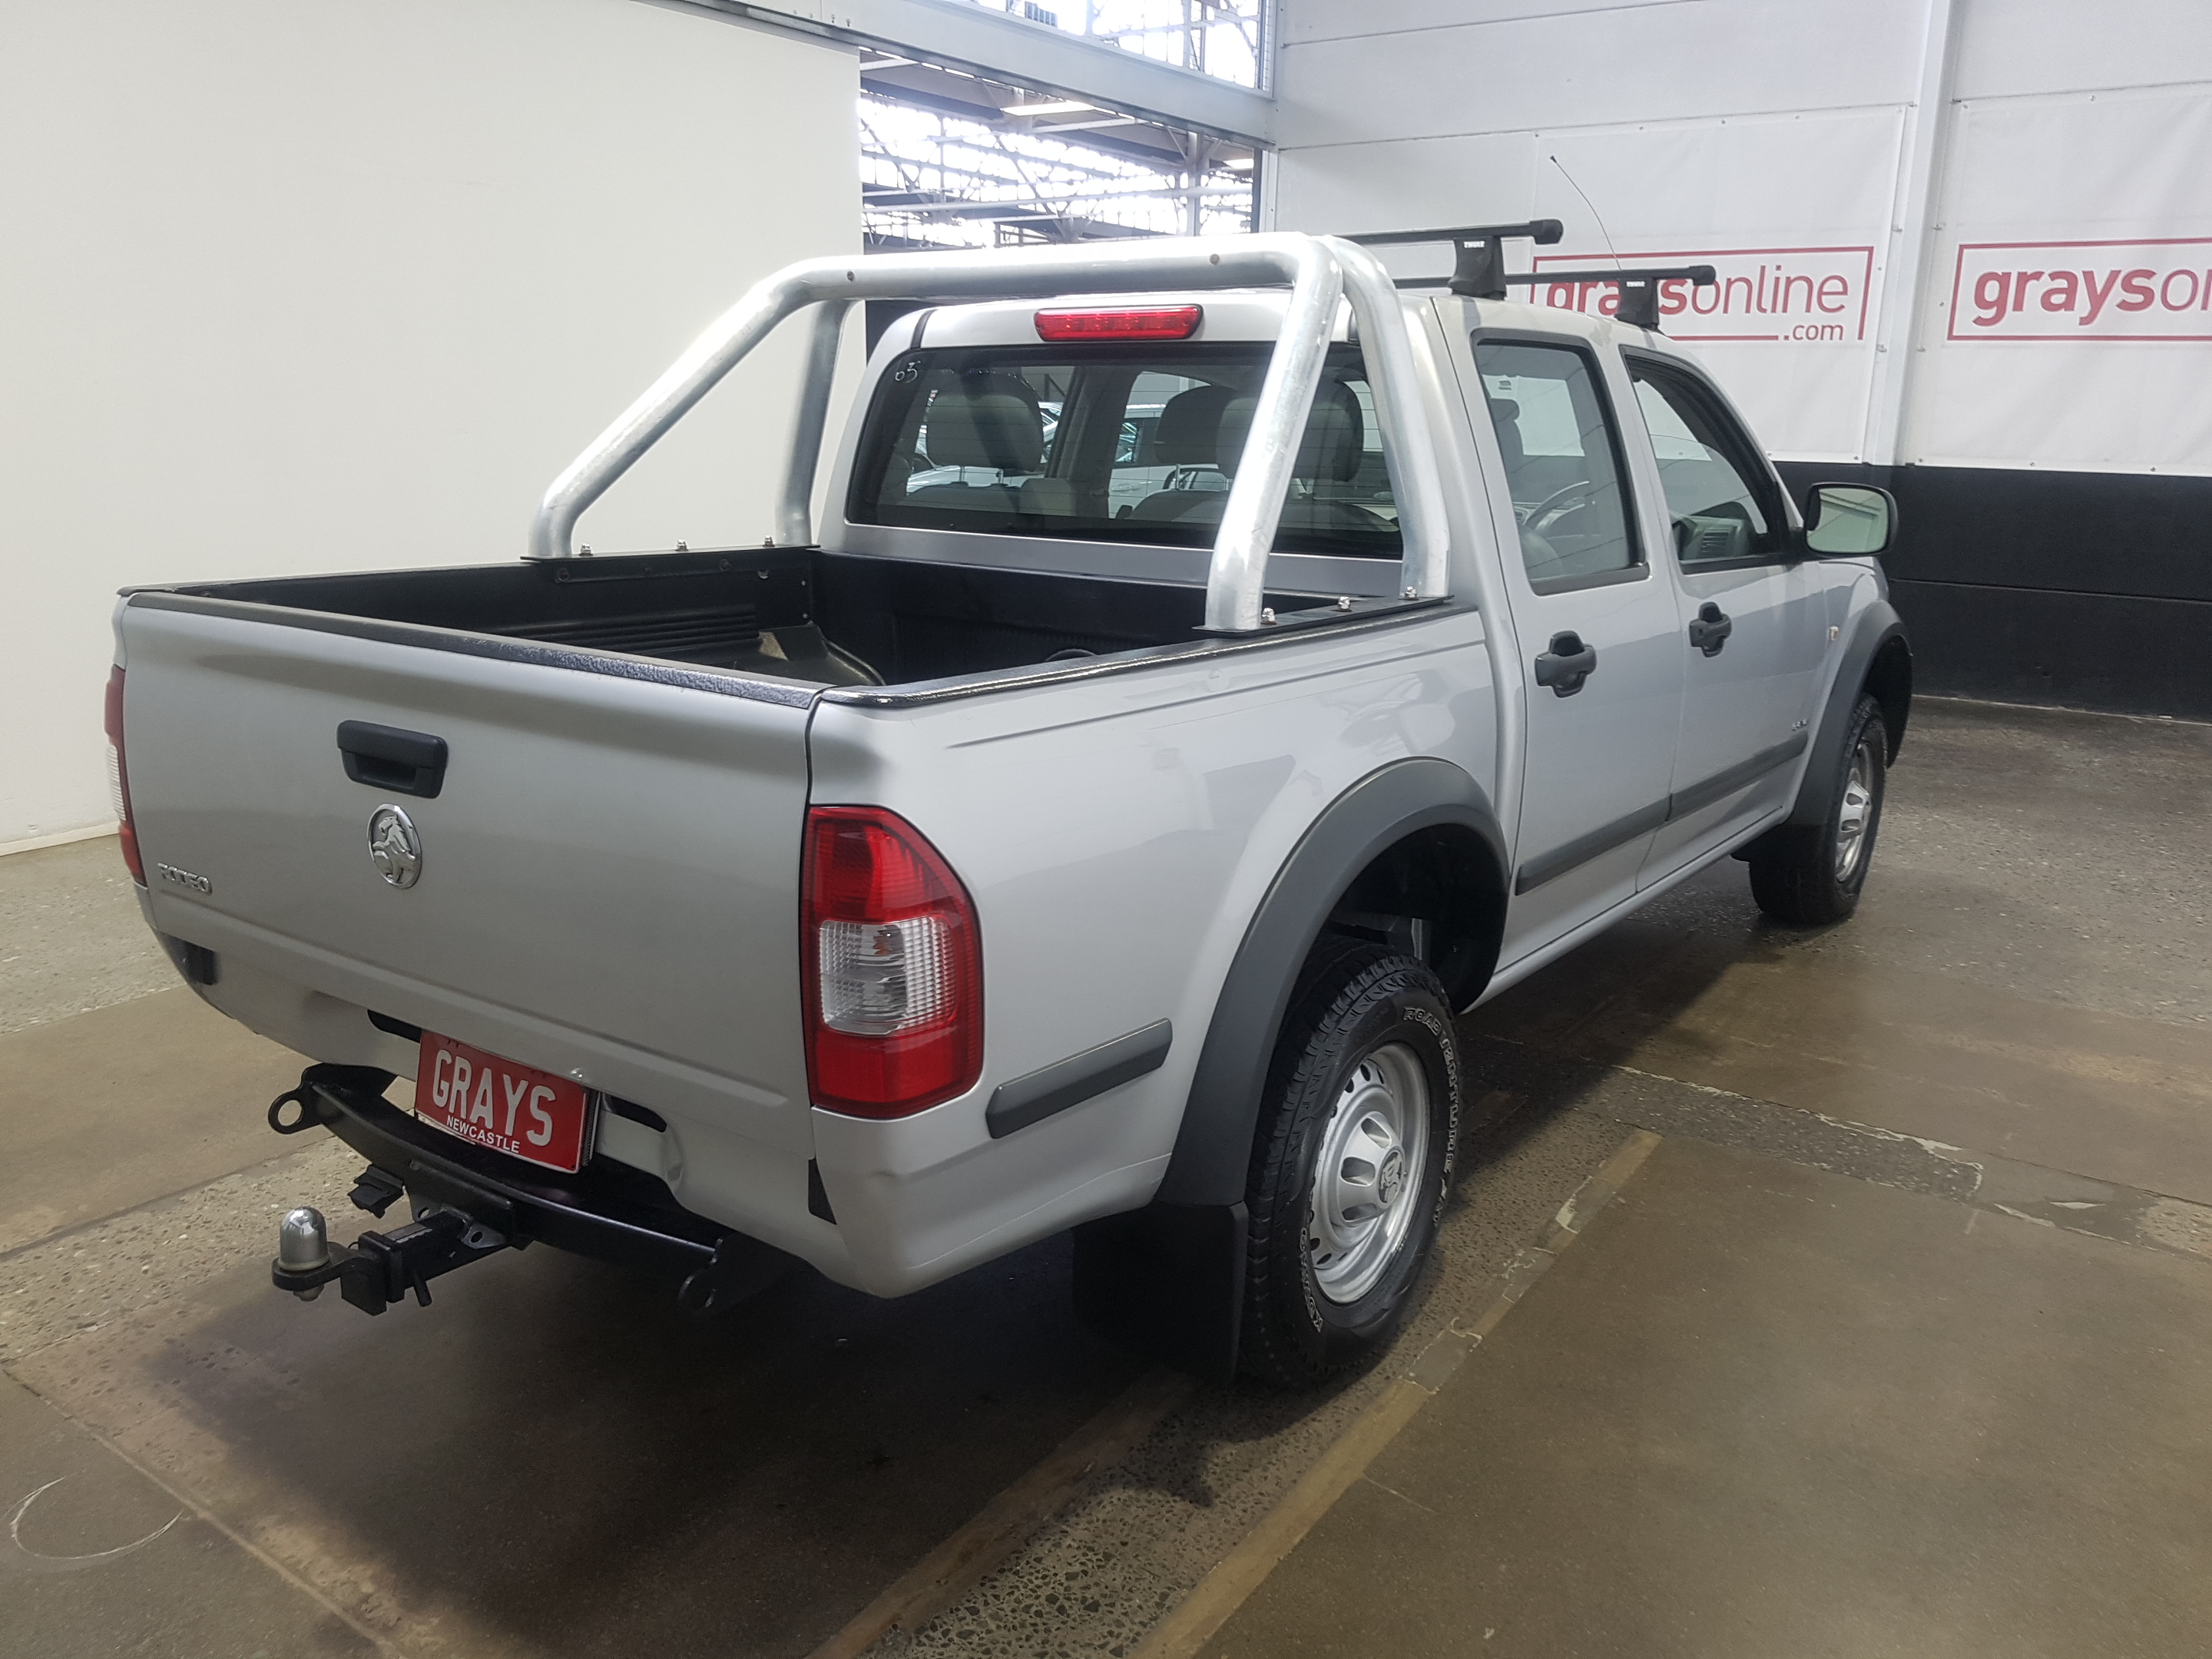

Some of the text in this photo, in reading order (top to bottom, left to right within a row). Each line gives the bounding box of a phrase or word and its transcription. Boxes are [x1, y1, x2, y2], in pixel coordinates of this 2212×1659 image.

[1547, 264, 1848, 315] grasonline
[1783, 324, 1844, 341] .com
[432, 1049, 556, 1147] GRAYS
[446, 1114, 521, 1154] NEWCASTLE
